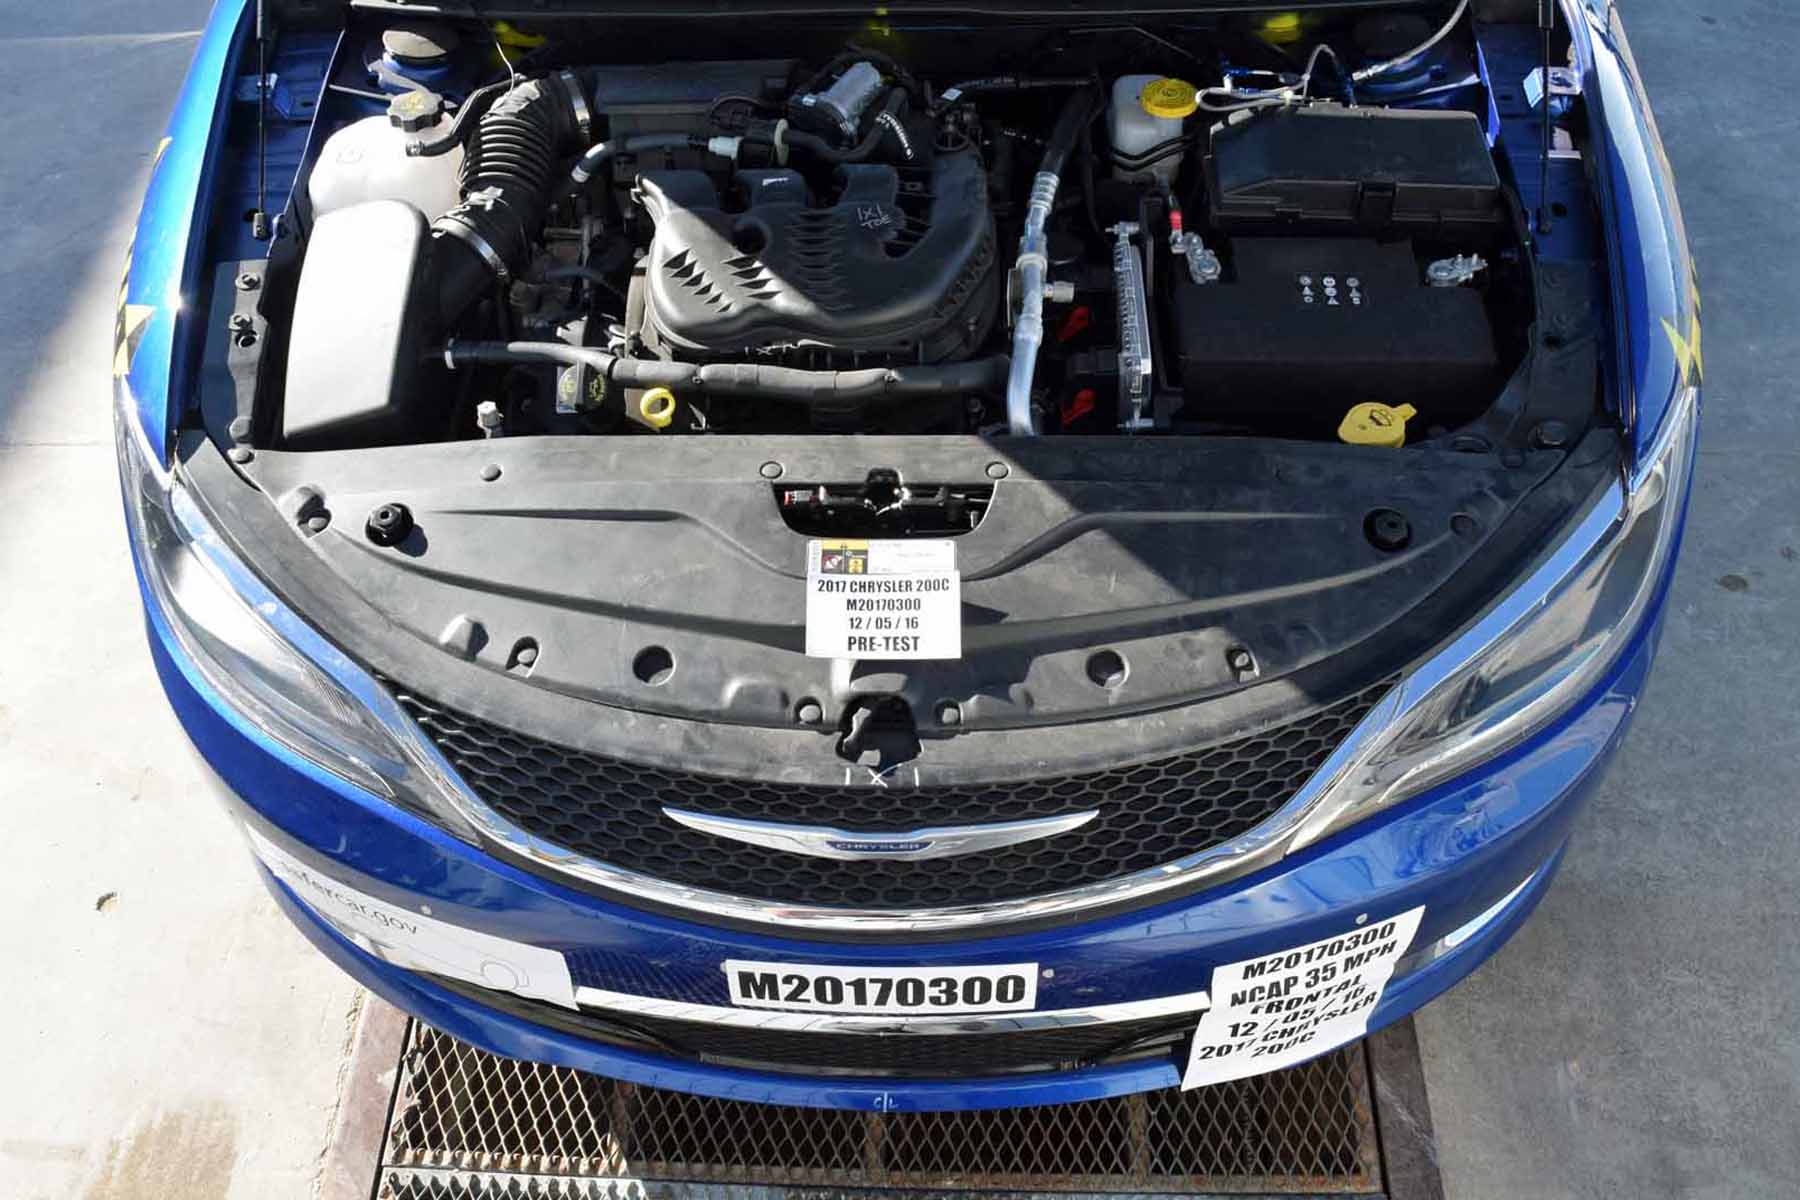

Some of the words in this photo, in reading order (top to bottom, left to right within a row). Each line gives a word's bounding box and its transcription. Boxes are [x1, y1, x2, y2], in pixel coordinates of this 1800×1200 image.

[818, 579, 847, 592] 2017
[850, 580, 913, 592] CHRYSLER
[916, 578, 950, 592] 200C
[846, 598, 921, 611] M20170300
[850, 617, 863, 630] 12
[875, 617, 892, 630] 05
[906, 616, 919, 630] 16
[848, 636, 921, 651] PRE-TEST
[1242, 922, 1396, 980] M20170300
[738, 970, 1026, 1007] M20170300
[1230, 975, 1298, 1008] NCAP
[1305, 962, 1337, 989] 35
[1343, 940, 1398, 973] MPH
[1250, 974, 1362, 1015] FRONTAL
[1198, 1038, 1258, 1061] 2017
[1261, 991, 1378, 1042] CHRYSLER
[1228, 1021, 1259, 1038] 12
[1282, 1007, 1315, 1025] 05
